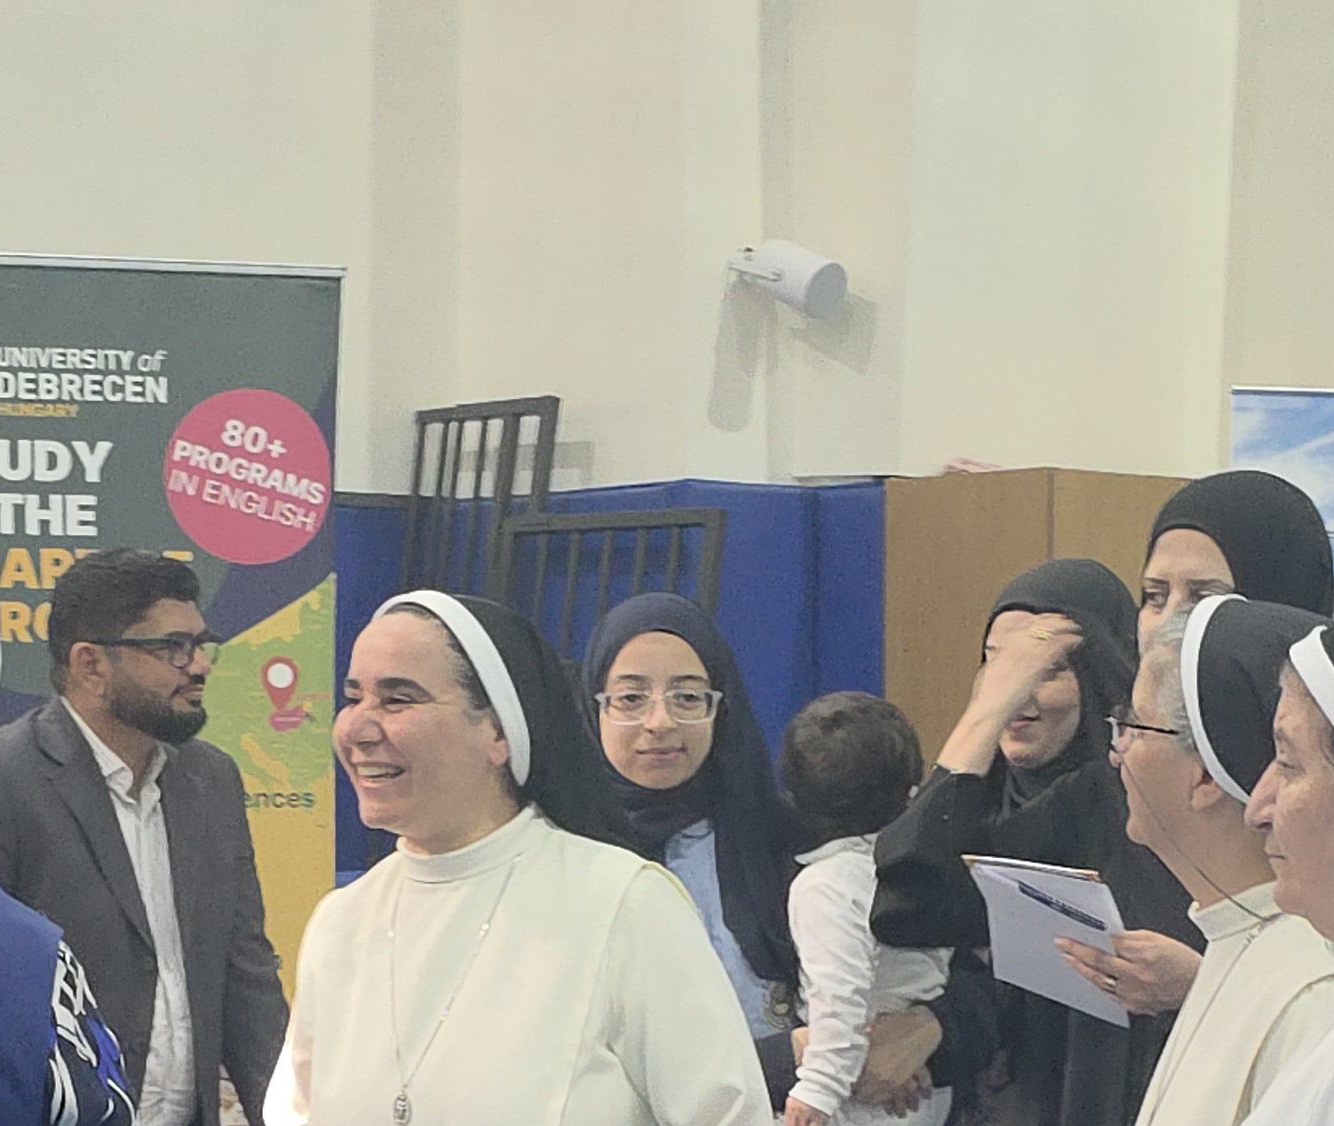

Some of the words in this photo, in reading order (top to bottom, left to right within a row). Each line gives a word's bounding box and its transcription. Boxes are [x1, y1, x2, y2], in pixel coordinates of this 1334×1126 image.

[137, 349, 168, 372] of
[220, 419, 288, 459] 80+
[171, 440, 327, 505] PROGRAMS
[168, 469, 198, 497] IN
[203, 480, 318, 533] ENGLISH
